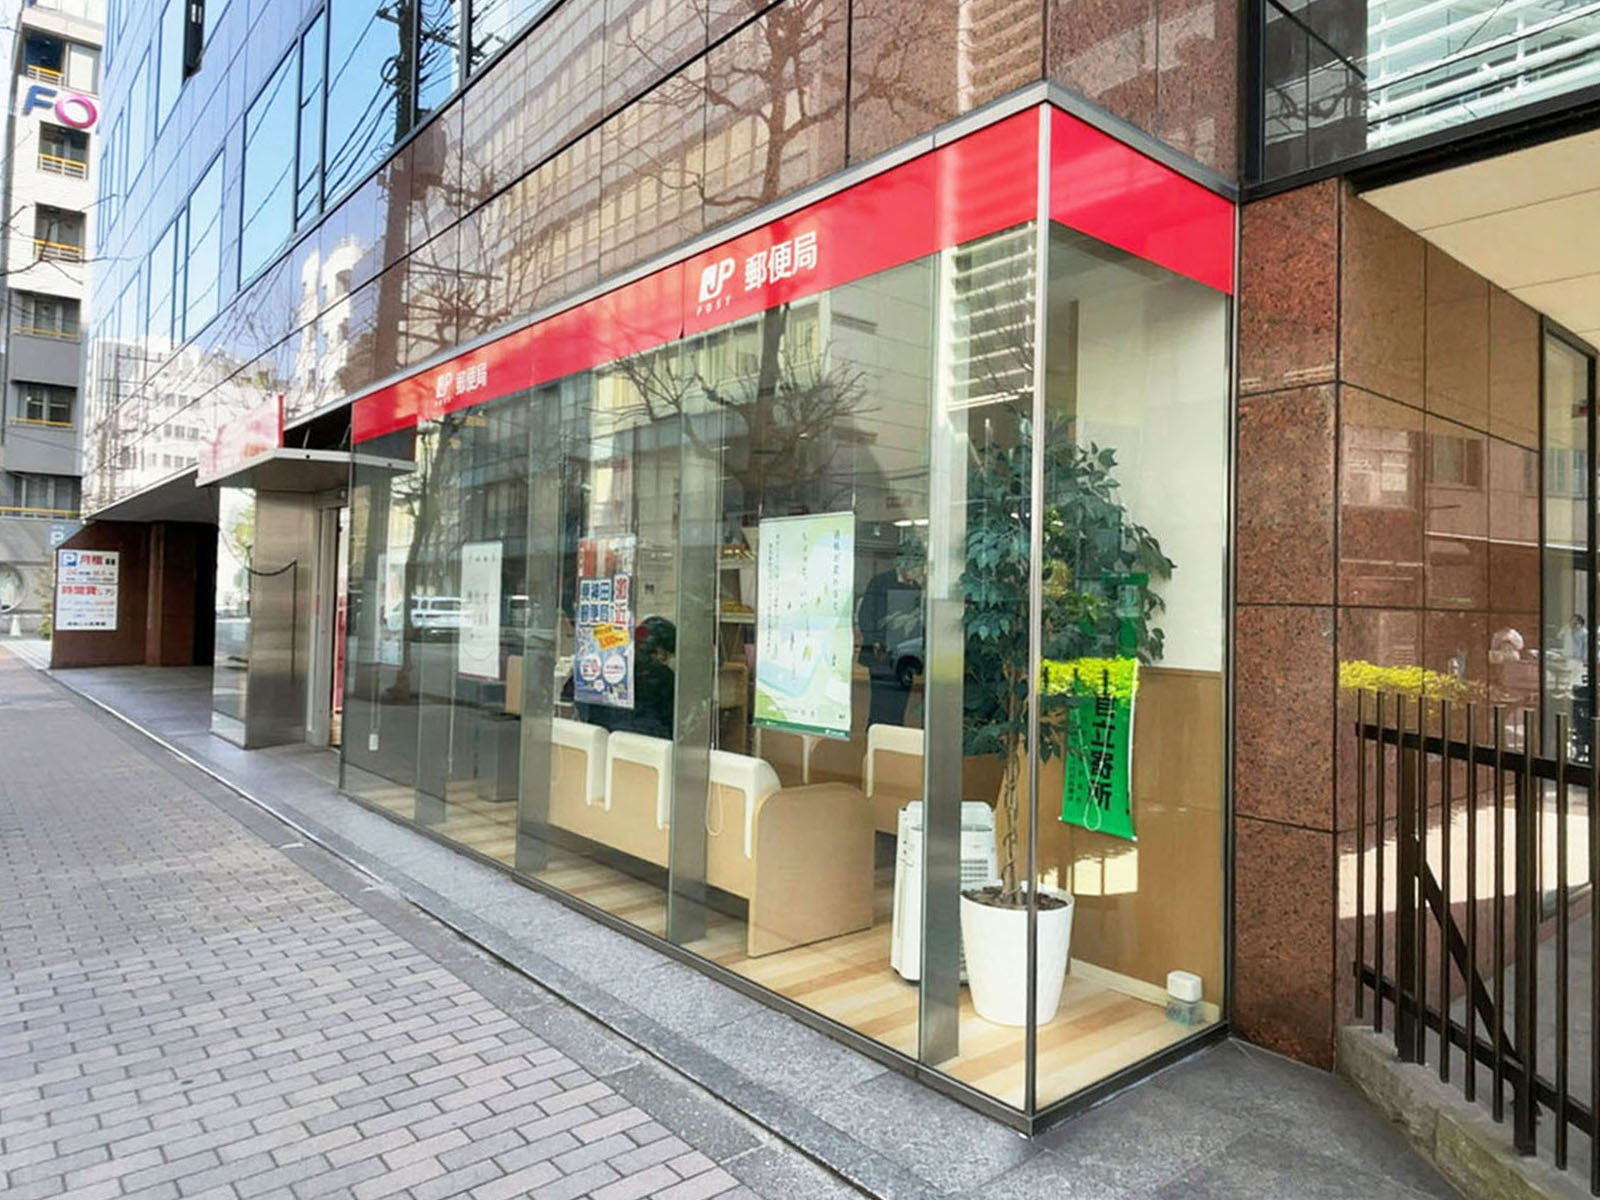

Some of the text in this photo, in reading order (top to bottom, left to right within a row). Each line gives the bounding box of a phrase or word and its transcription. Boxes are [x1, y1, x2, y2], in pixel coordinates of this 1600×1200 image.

[744, 231, 818, 291] 郵便局
[455, 362, 487, 396] 郵便局
